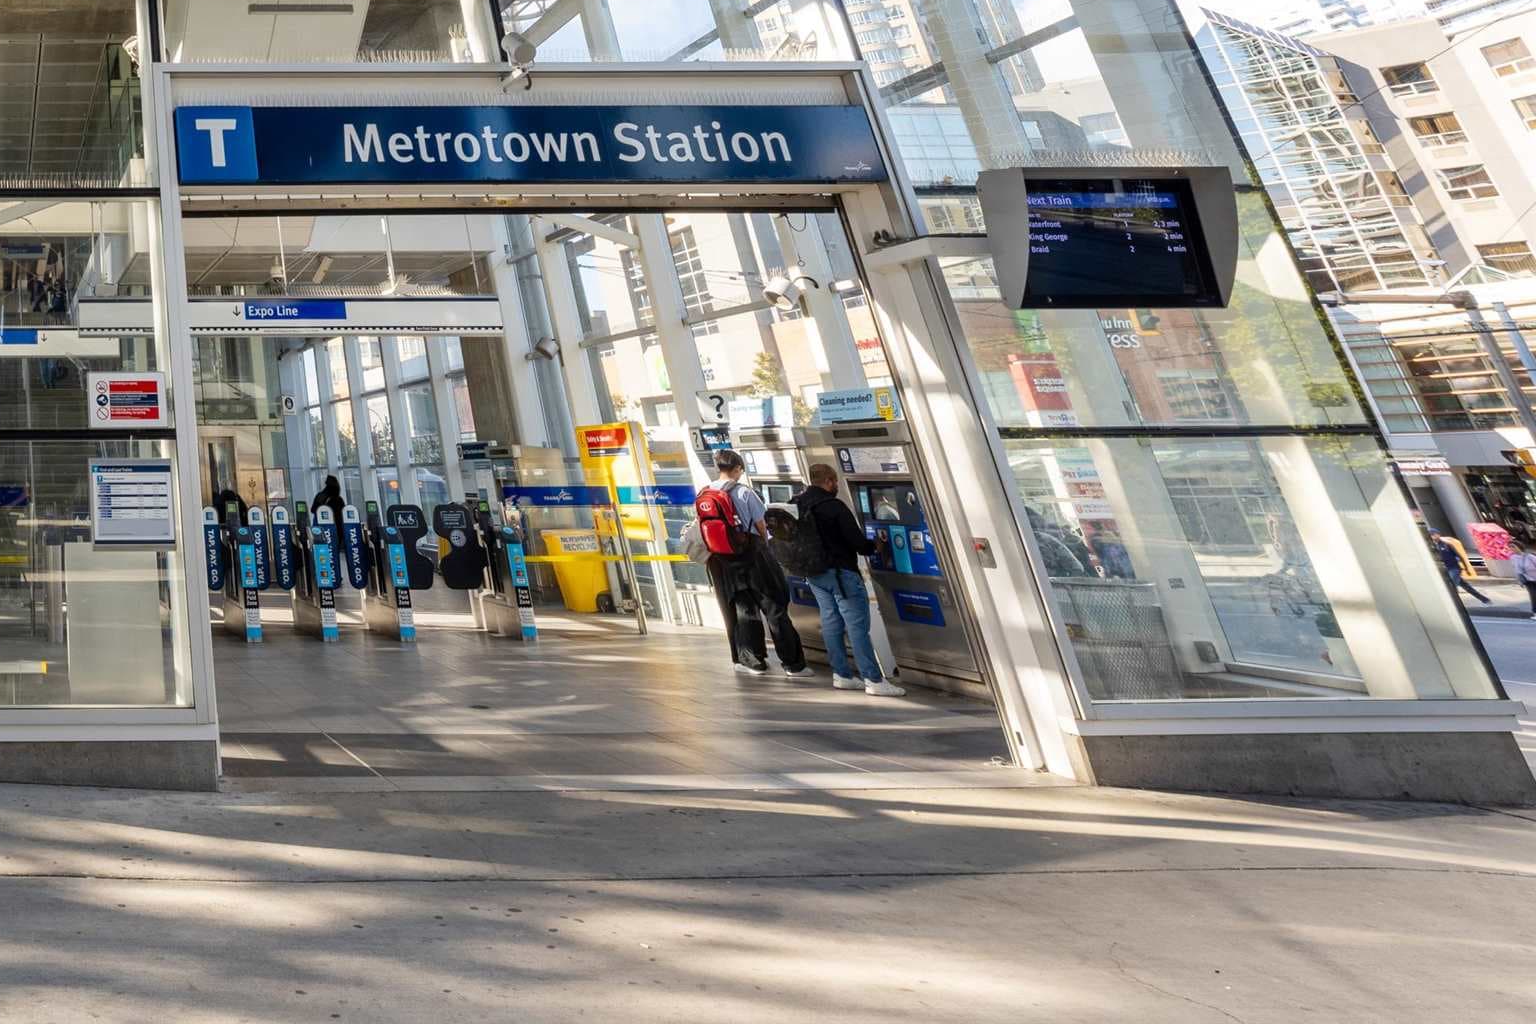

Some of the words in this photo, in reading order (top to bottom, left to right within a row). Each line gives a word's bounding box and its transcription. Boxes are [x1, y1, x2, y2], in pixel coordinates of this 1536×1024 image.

[195, 118, 237, 168] T
[343, 122, 601, 164] Metrotown
[613, 121, 793, 163] Station
[1047, 195, 1072, 206] Train
[1044, 233, 1068, 242] George
[1125, 232, 1132, 241] 2
[1169, 232, 1184, 240] min
[1031, 246, 1050, 254] Braid
[1173, 244, 1187, 252] min
[248, 305, 274, 319] Expo
[276, 305, 299, 317] Line
[819, 396, 845, 407] Cleaning
[846, 393, 873, 404] needed?
[207, 529, 216, 547] TAP.
[254, 529, 262, 545] GO.
[277, 528, 286, 547] TAP.
[349, 528, 358, 546] TAP.
[208, 548, 218, 568] PAY.
[256, 546, 264, 566] PAY.
[278, 548, 288, 568] PAY.
[351, 547, 361, 567] PAY.
[211, 569, 219, 585] GO.
[257, 566, 265, 585] TAP.
[282, 568, 290, 585] GO.
[354, 568, 363, 584] GO.
